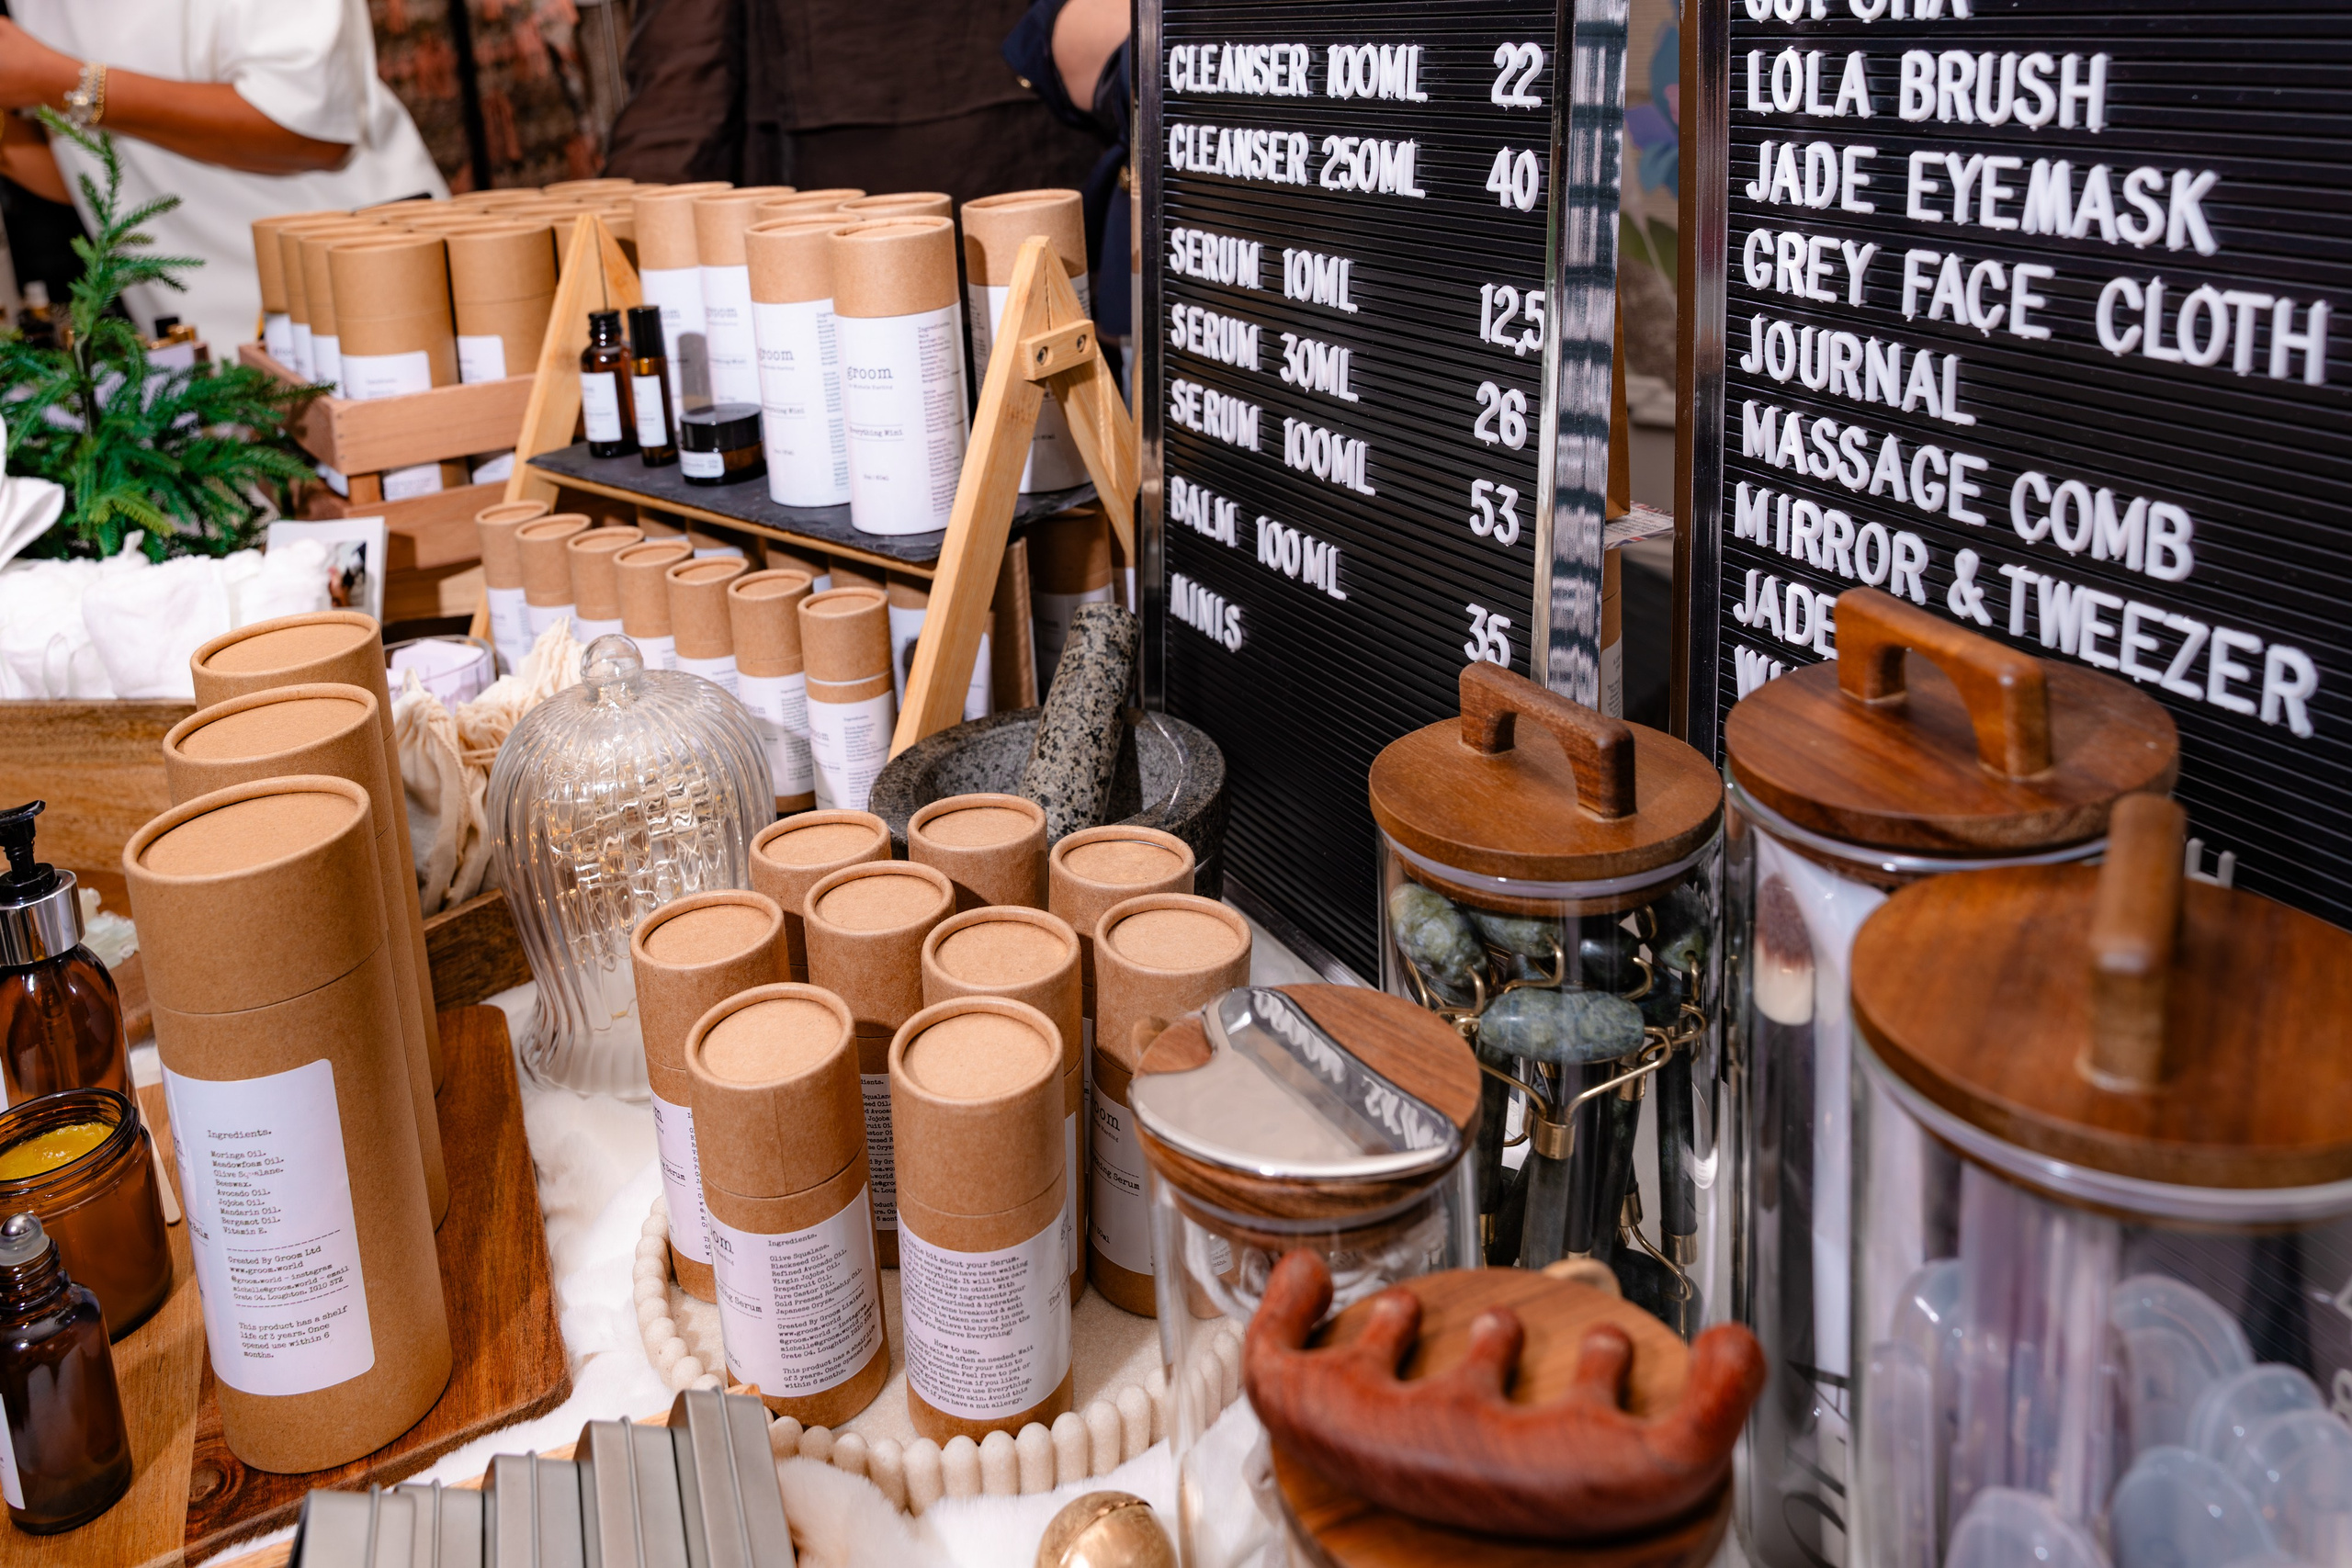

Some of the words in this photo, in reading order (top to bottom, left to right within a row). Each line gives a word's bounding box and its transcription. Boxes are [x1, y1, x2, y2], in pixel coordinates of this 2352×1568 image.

[1170, 42, 1308, 96] CLEANSER
[1327, 43, 1428, 102] 100ML
[1491, 42, 1544, 107] 22
[1747, 46, 1874, 118] LOLA
[1899, 50, 2109, 133] BRUSH
[1170, 123, 1308, 186] CLEANSER
[1320, 134, 1425, 198] 250ML
[1487, 146, 1539, 212] 40
[1747, 140, 1877, 213] JADE
[1907, 150, 2221, 256] EYEMASK
[1170, 227, 1260, 288] SERUM
[1283, 248, 1359, 313] 10ML
[1743, 228, 1880, 308] GREY
[1902, 248, 2055, 339] FACE
[2096, 276, 2328, 386] CLOTH
[847, 367, 893, 380] groom
[1170, 302, 1260, 371] SERUM
[1281, 332, 1359, 402] 30ML
[1474, 381, 1528, 451] 26
[1740, 314, 1975, 425] JOURNAL
[1170, 378, 1260, 452] SERUM
[1283, 417, 1375, 496] 100ML
[1469, 479, 1520, 546] 53
[1742, 399, 1988, 527] MASSAGE
[2009, 470, 2194, 582] COMB
[1170, 475, 1237, 547] BALM
[1256, 514, 1347, 601] 100ML
[1464, 603, 1510, 669] 35
[1170, 573, 1242, 653] MINIS
[1733, 569, 1839, 660] JADE
[1735, 480, 1928, 604] MIRROR
[1947, 548, 1993, 627] &
[1998, 562, 2319, 738] TWEEZER
[208, 1129, 272, 1140] Ingredients.
[265, 1157, 284, 1165] Oil.
[1114, 1173, 1140, 1190] Serum
[262, 1206, 281, 1214] Oil.
[768, 1233, 817, 1247] Ingredients.
[262, 1257, 272, 1265] By
[275, 1252, 303, 1263] Groom
[305, 1246, 321, 1256] Ltd
[793, 1244, 830, 1259] Squalane.
[811, 1253, 826, 1262] Oil.
[230, 1261, 304, 1275] www.groom.world
[291, 1263, 333, 1280] instagram
[772, 1268, 802, 1277] Refined
[804, 1258, 833, 1272] Avocado
[834, 1249, 847, 1259] Oil.
[801, 1268, 825, 1281] Jojoba
[826, 1262, 841, 1272] Oil.
[940, 1258, 963, 1268] about
[967, 1262, 988, 1270] your
[990, 1256, 1019, 1267] Serum.
[326, 1266, 350, 1279] email
[773, 1281, 816, 1293] Grapefruit
[817, 1275, 832, 1283] Oil.
[793, 1287, 819, 1297] Castor
[820, 1281, 835, 1290] Oil.
[795, 1293, 823, 1305] Pressed
[825, 1278, 851, 1297] Rosehip
[735, 1296, 762, 1313] Serum
[959, 1292, 1006, 1301] ingredients
[238, 1322, 257, 1330] This
[259, 1322, 294, 1332] product
[296, 1318, 312, 1327] has
[322, 1305, 348, 1320] shelf
[776, 1305, 810, 1315] Japanese
[778, 1321, 807, 1330] Created
[809, 1318, 818, 1326] By
[820, 1309, 841, 1321] Groom
[779, 1315, 841, 1337] www.groom.world
[240, 1331, 257, 1340] life
[277, 1329, 305, 1341] years.
[307, 1323, 330, 1334] Once
[288, 1335, 322, 1347] within
[818, 1335, 850, 1354] Loughton
[934, 1339, 948, 1349] How
[800, 1371, 824, 1381] years.
[825, 1363, 842, 1373] Once
[843, 1348, 863, 1365] opened
[802, 1360, 832, 1373] product
[833, 1353, 845, 1362] has
[988, 1352, 1016, 1363] needed.
[819, 1369, 846, 1383] months.
[987, 1377, 1032, 1393] Everything.
[1012, 1387, 1028, 1396] this
[992, 1397, 1023, 1408] allergy.
